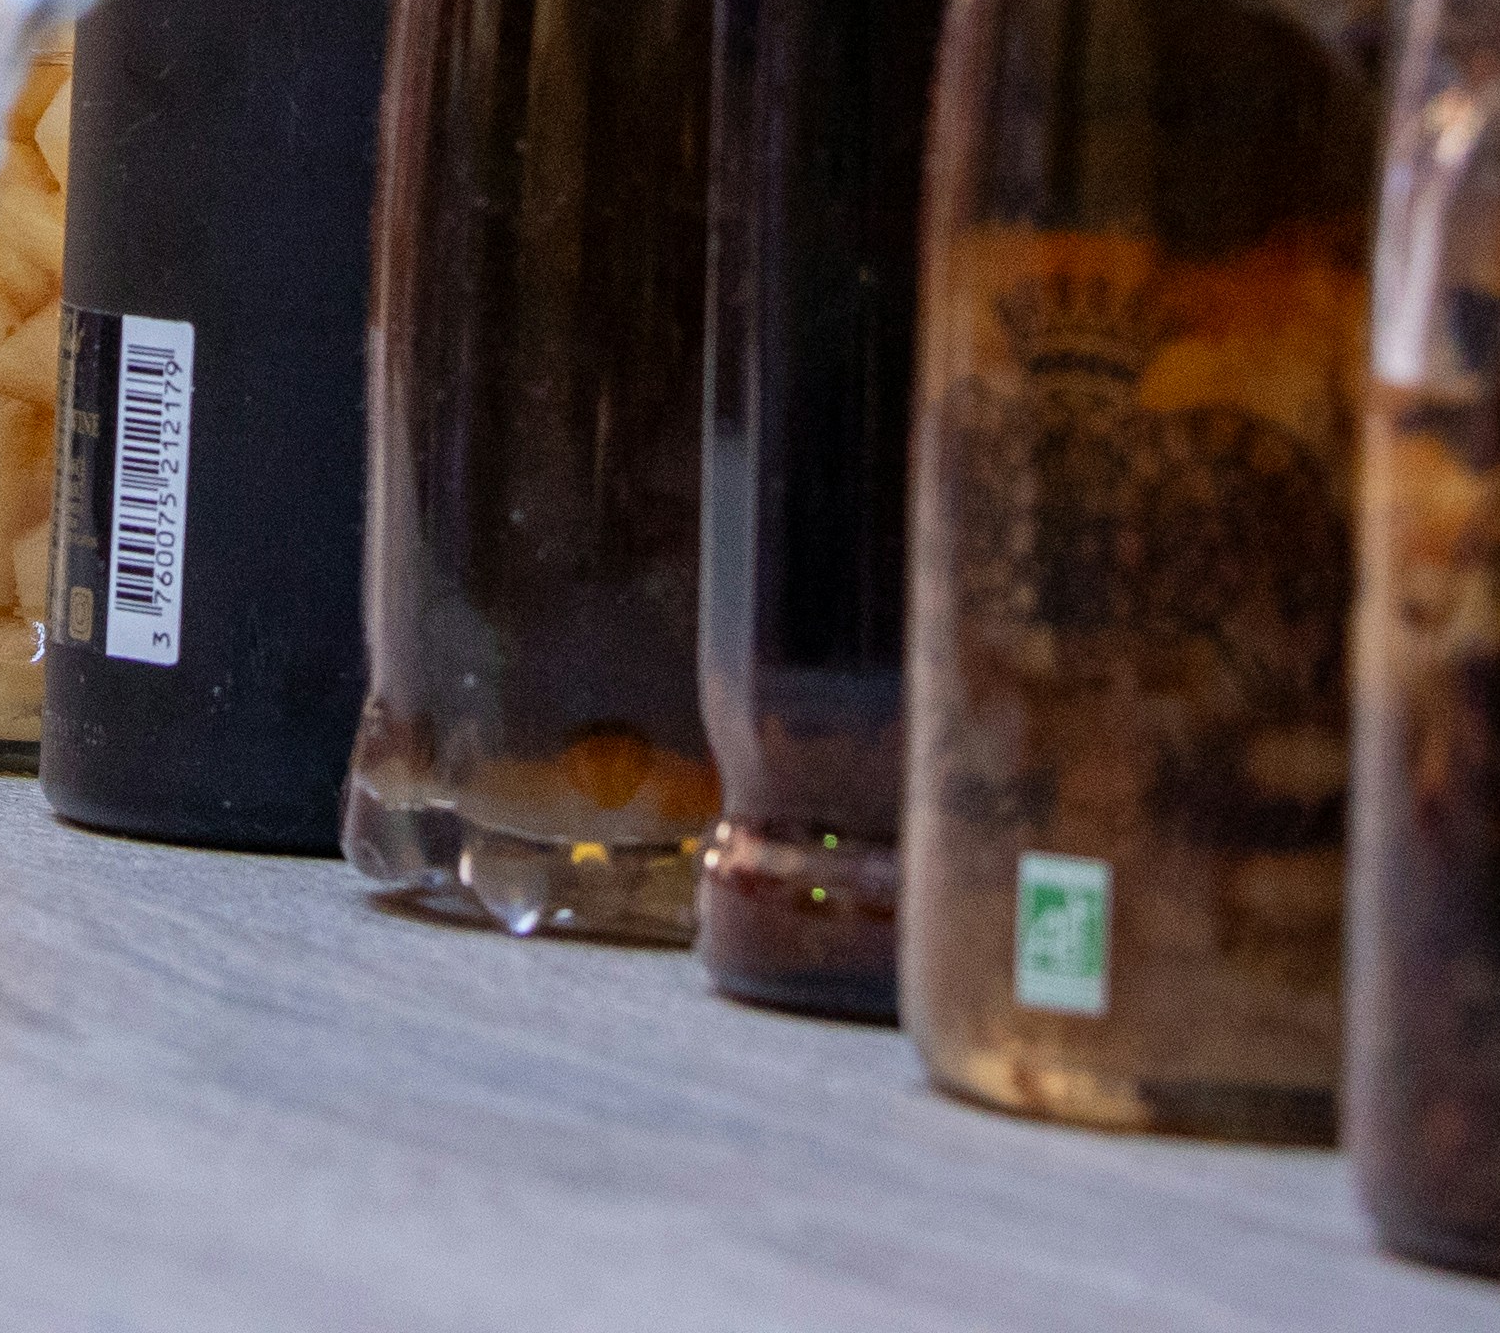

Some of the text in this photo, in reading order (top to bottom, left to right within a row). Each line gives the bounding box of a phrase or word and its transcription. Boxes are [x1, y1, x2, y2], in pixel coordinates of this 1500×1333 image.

[152, 359, 183, 649] 3 760075 212179
